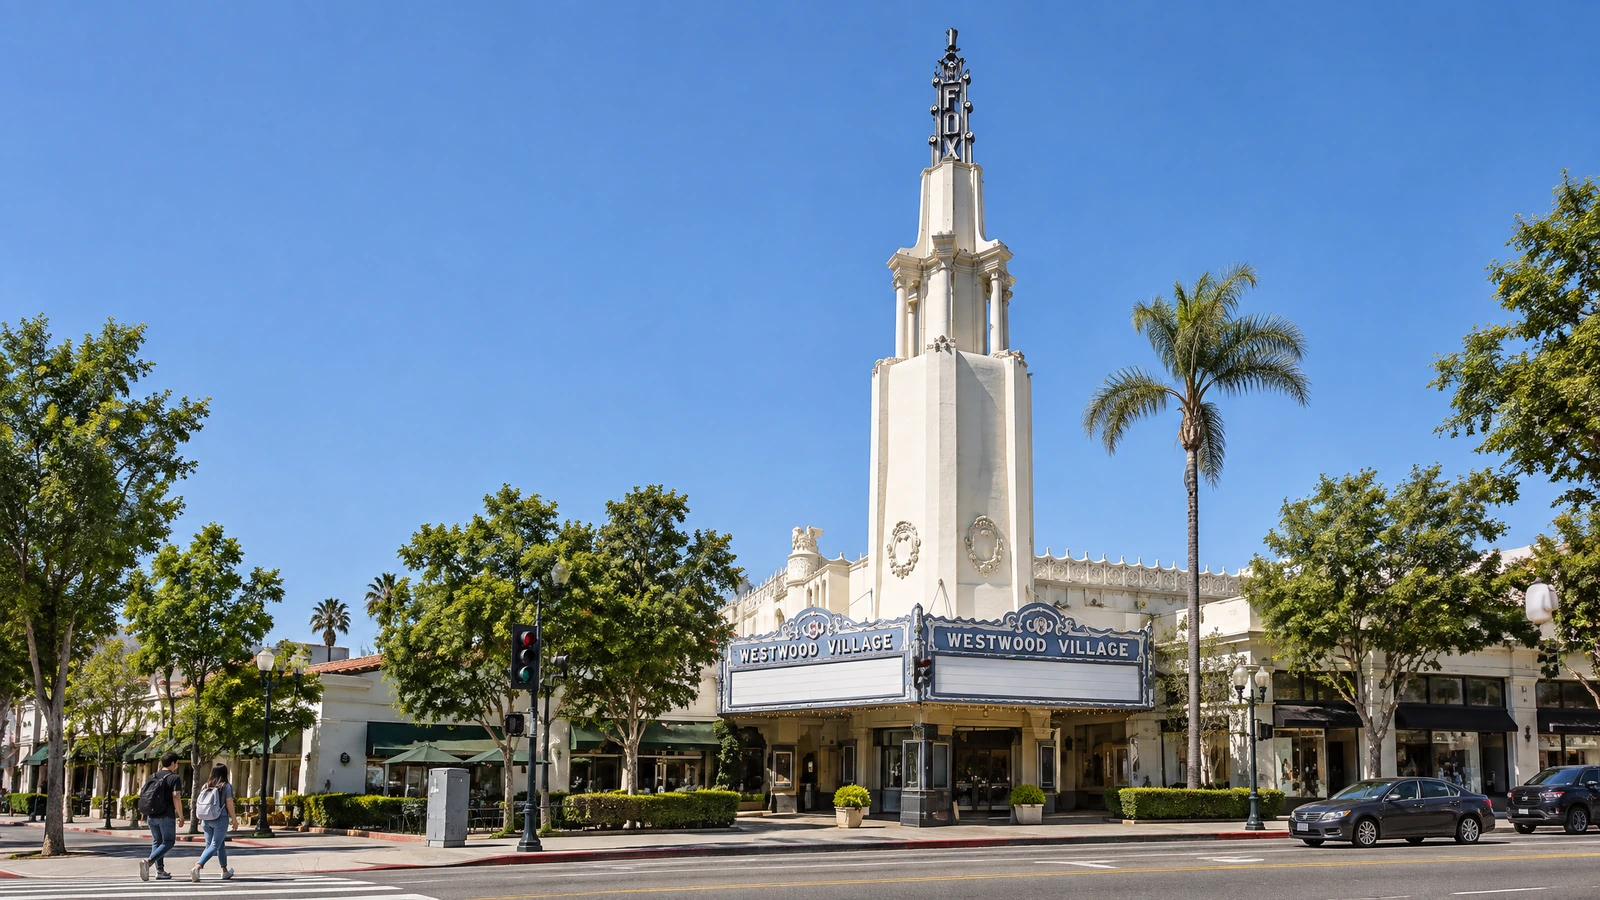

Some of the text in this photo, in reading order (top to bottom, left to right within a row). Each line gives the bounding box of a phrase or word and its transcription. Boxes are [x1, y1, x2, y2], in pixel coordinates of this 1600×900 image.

[943, 86, 960, 160] FOX
[739, 633, 893, 663] WESTWOOD VILLAGE
[946, 632, 1129, 657] WESTWOOD VILLAGE
